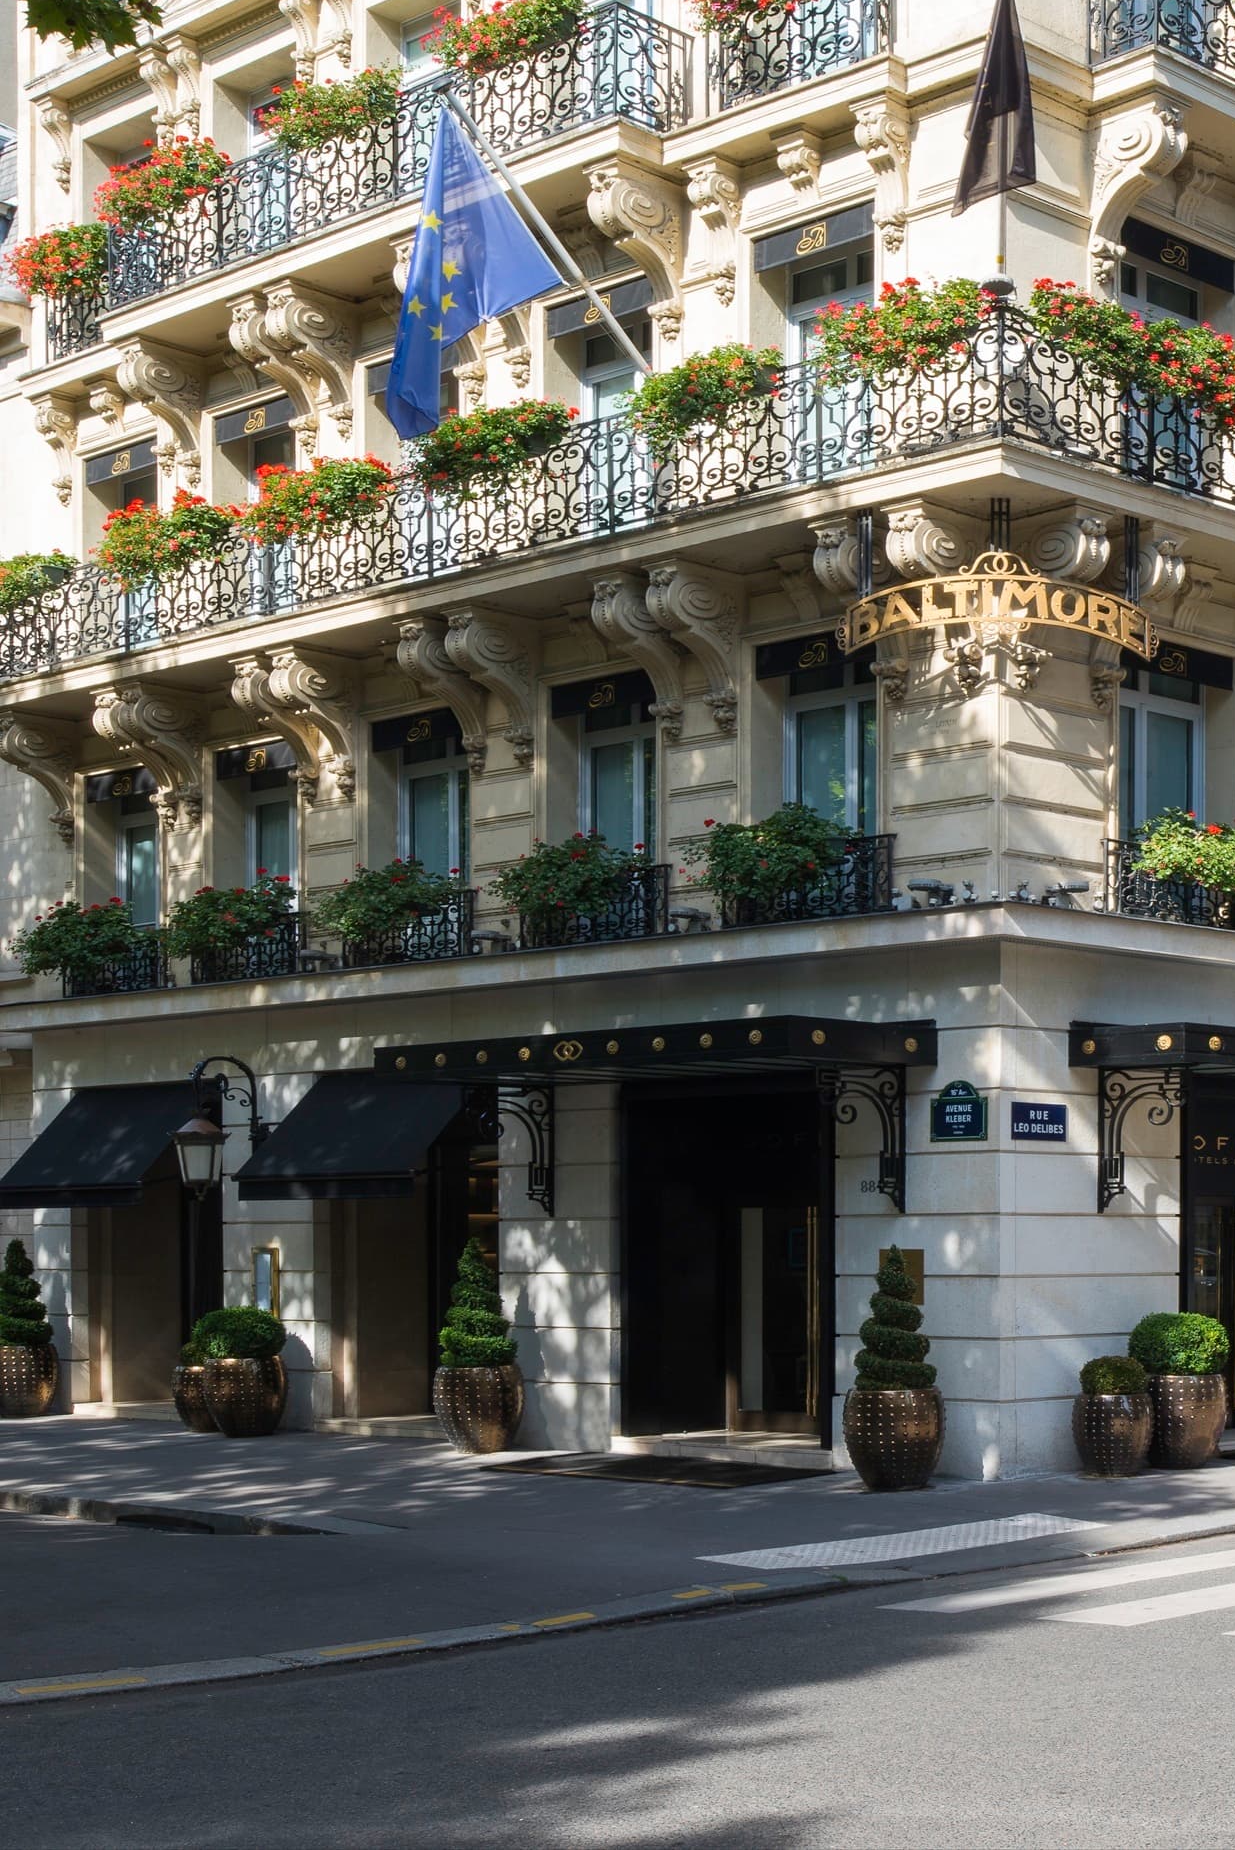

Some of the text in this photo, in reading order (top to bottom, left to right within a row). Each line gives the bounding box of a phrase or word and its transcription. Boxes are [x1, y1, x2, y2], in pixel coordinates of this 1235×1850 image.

[852, 580, 1143, 641] BALTIMORE
[945, 1104, 973, 1113] AVENUE
[1029, 1110, 1049, 1120] RUE
[1031, 1123, 1064, 1135] DELIBES
